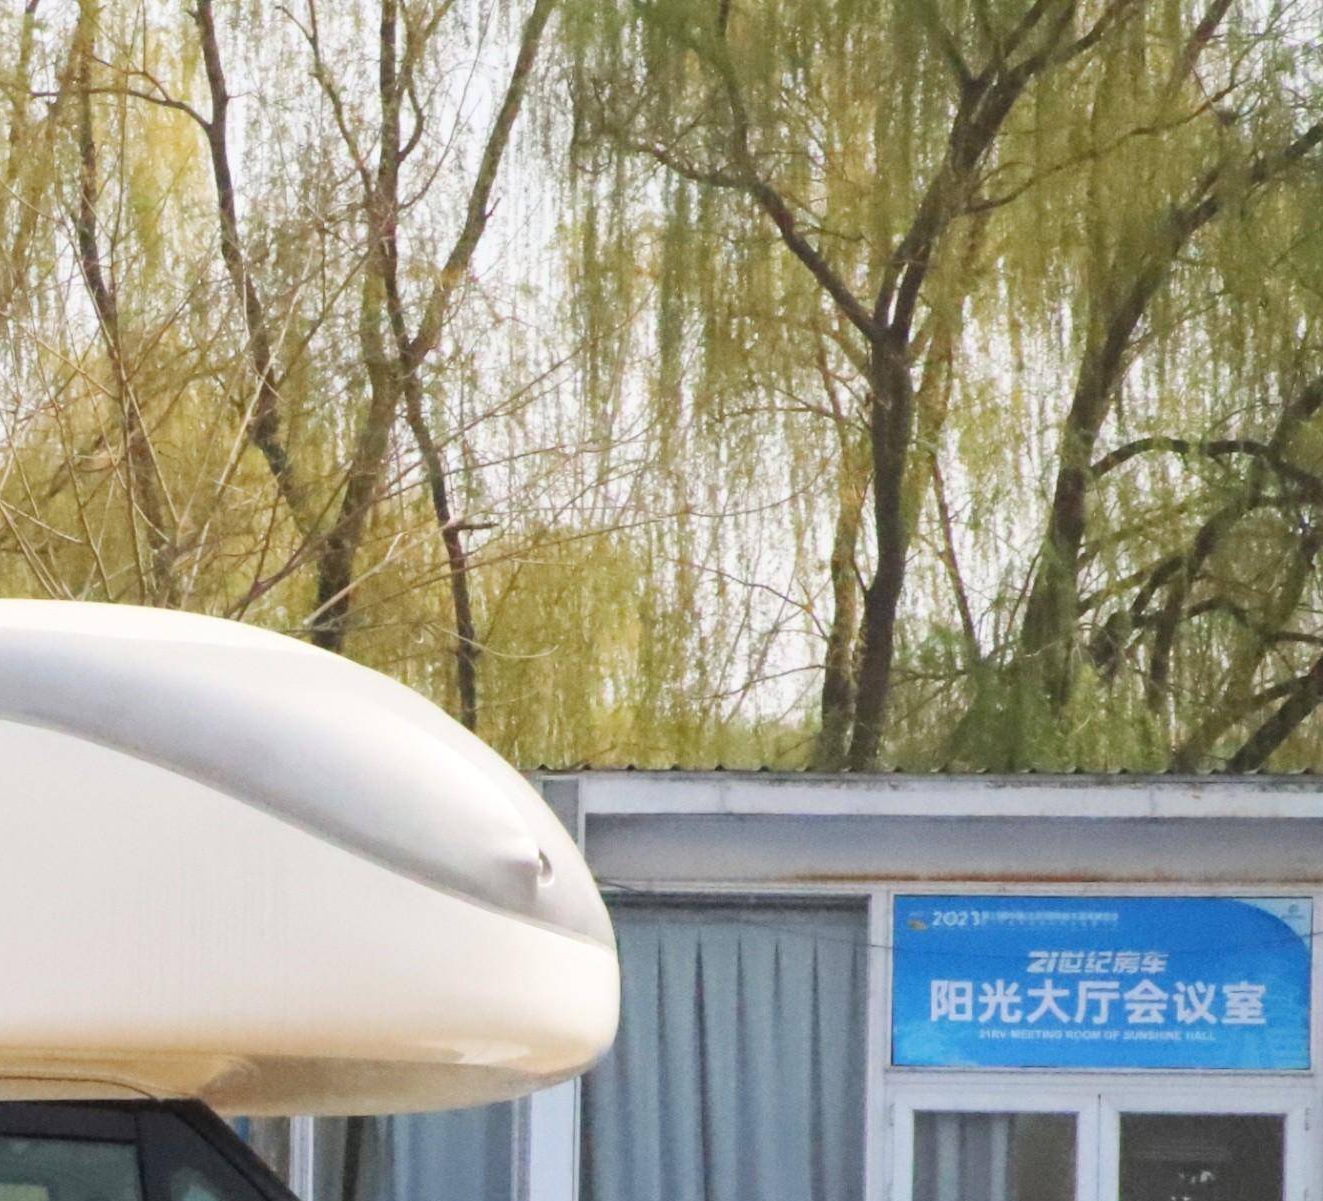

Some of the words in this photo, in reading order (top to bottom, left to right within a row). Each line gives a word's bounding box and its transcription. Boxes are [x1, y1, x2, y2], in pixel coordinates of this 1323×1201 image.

[932, 910, 982, 927] 2023
[1026, 951, 1169, 974] 21世纪房车
[930, 980, 1267, 1025] 阳光大厅会议室
[1010, 1029, 1063, 1040] MEETING
[1065, 1030, 1101, 1040] ROOM
[1104, 1030, 1120, 1040] OF
[1123, 1030, 1182, 1041] SUNSHINE
